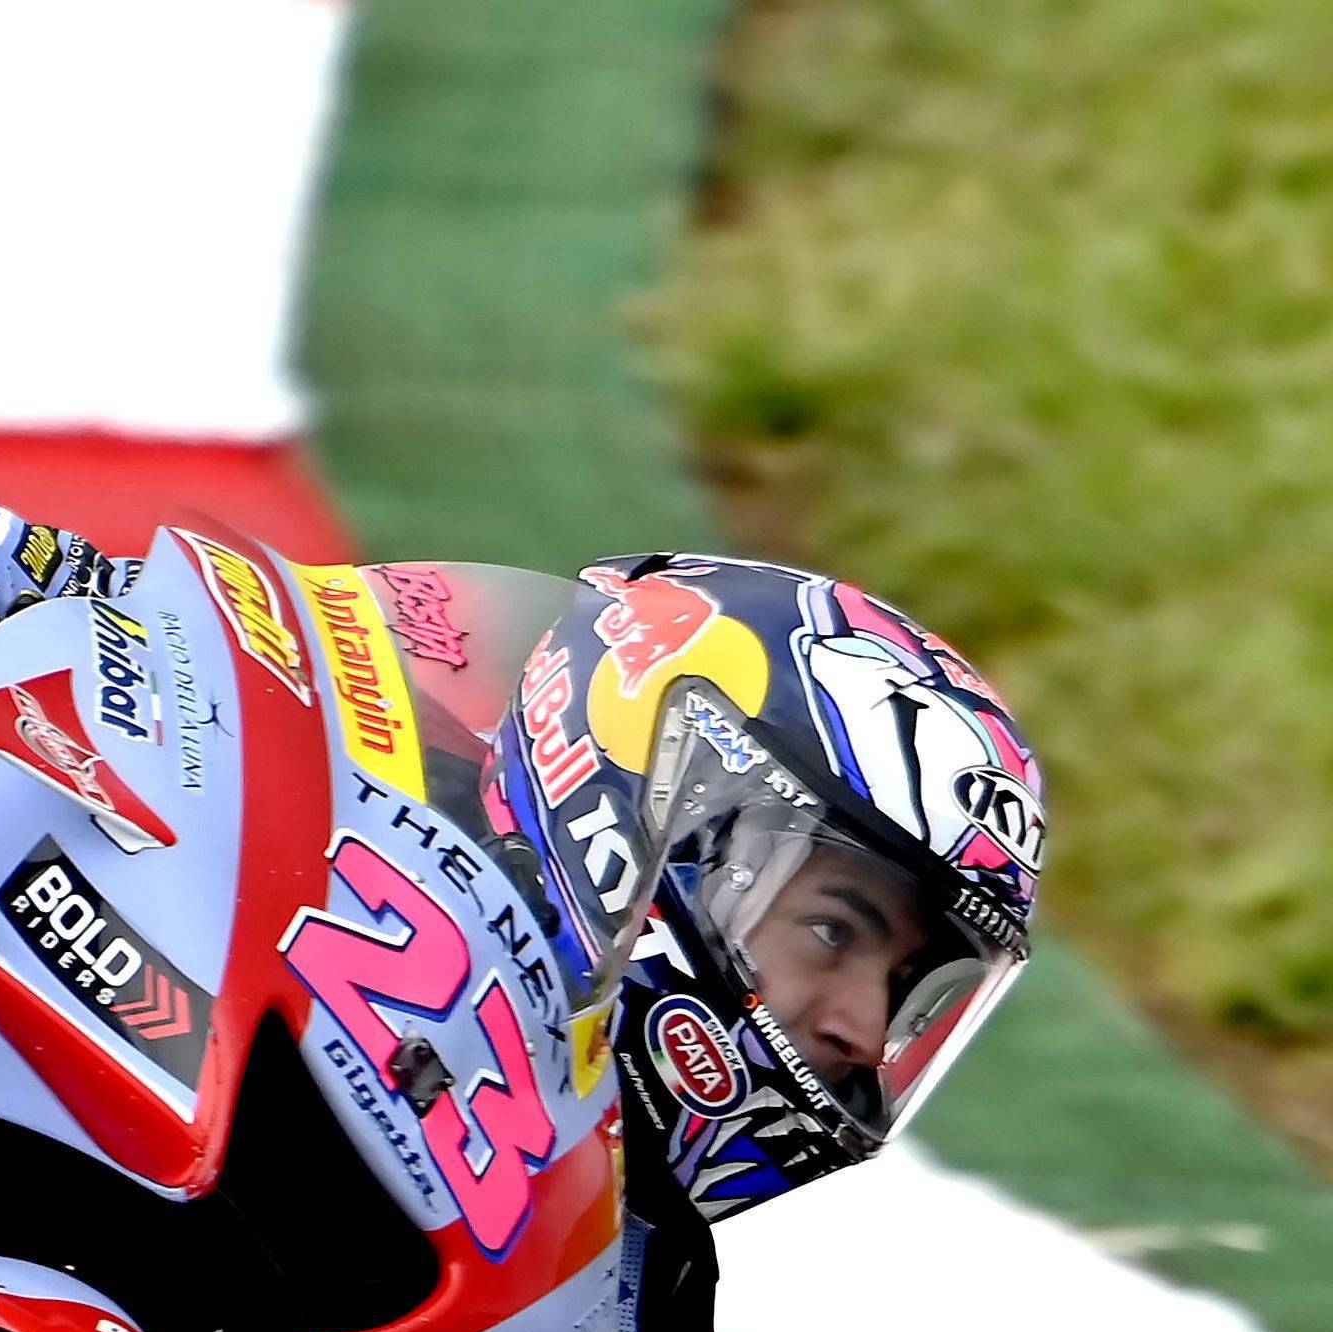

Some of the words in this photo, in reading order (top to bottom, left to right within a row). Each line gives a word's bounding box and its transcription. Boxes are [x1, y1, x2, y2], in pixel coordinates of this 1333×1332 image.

[310, 576, 407, 757] Antangin
[353, 771, 484, 894] THE
[11, 892, 114, 1007] RIDERS
[25, 864, 144, 988] BOLD
[277, 827, 556, 1264] 23
[666, 1020, 727, 1097] PATA
